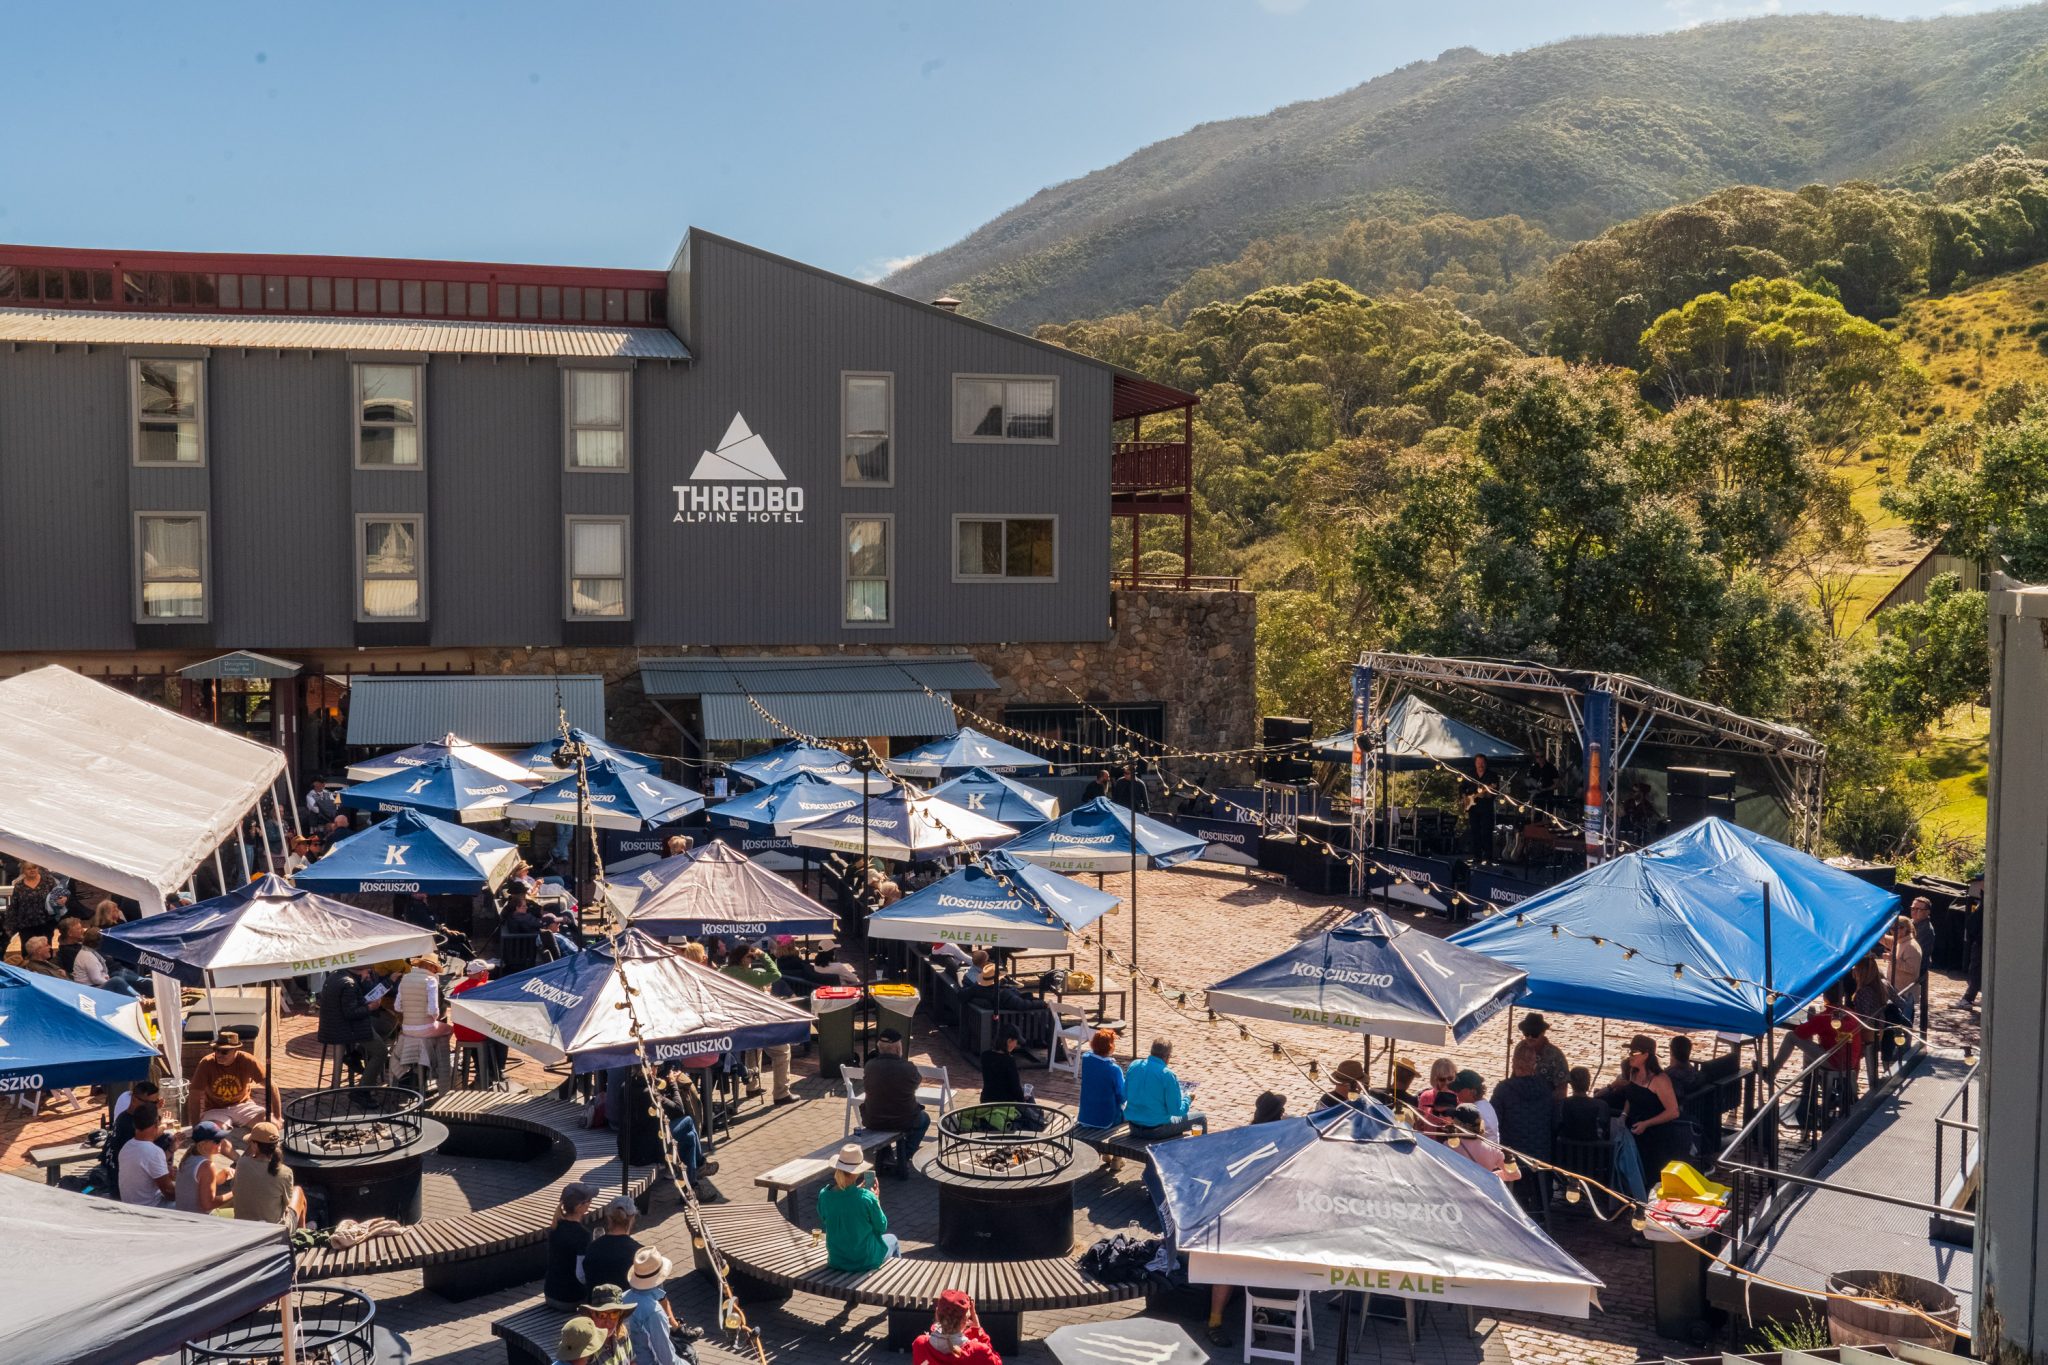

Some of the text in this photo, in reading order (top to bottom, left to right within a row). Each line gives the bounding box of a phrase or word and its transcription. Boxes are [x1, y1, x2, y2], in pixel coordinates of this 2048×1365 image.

[672, 485, 804, 512] THREDBO
[673, 511, 804, 523] ALPINE HOTEL
[405, 778, 433, 794] K
[967, 793, 986, 810] K
[554, 814, 576, 823] PALE
[834, 840, 853, 850] PALE
[1048, 832, 1115, 844] KOSCIUSZKO
[1198, 830, 1245, 844] KOSCIUSZKO
[383, 844, 410, 865] K
[620, 840, 663, 852] KOSCIUS
[1050, 861, 1094, 869] PALE ALE
[359, 881, 420, 894] KOSCIUSZKO
[938, 894, 1023, 911] KOSCIUSZKO
[702, 922, 767, 935] KOSCIUSZKO
[940, 930, 998, 943] PALE ALE
[137, 951, 176, 974] KOSCIUSZKO
[292, 953, 357, 972] PALE ALE
[1417, 949, 1455, 979] K
[1291, 961, 1394, 988] KOSCIUSZKO
[520, 977, 584, 1009] KOSCIUSZKO
[1292, 1007, 1361, 1028] PALE ALE
[490, 1023, 526, 1047] PALE ALE
[656, 1035, 733, 1060] KOSCIUSZKO
[1296, 1189, 1463, 1225] KOSCIUSZKO
[1330, 1267, 1444, 1294] PALE ALE
